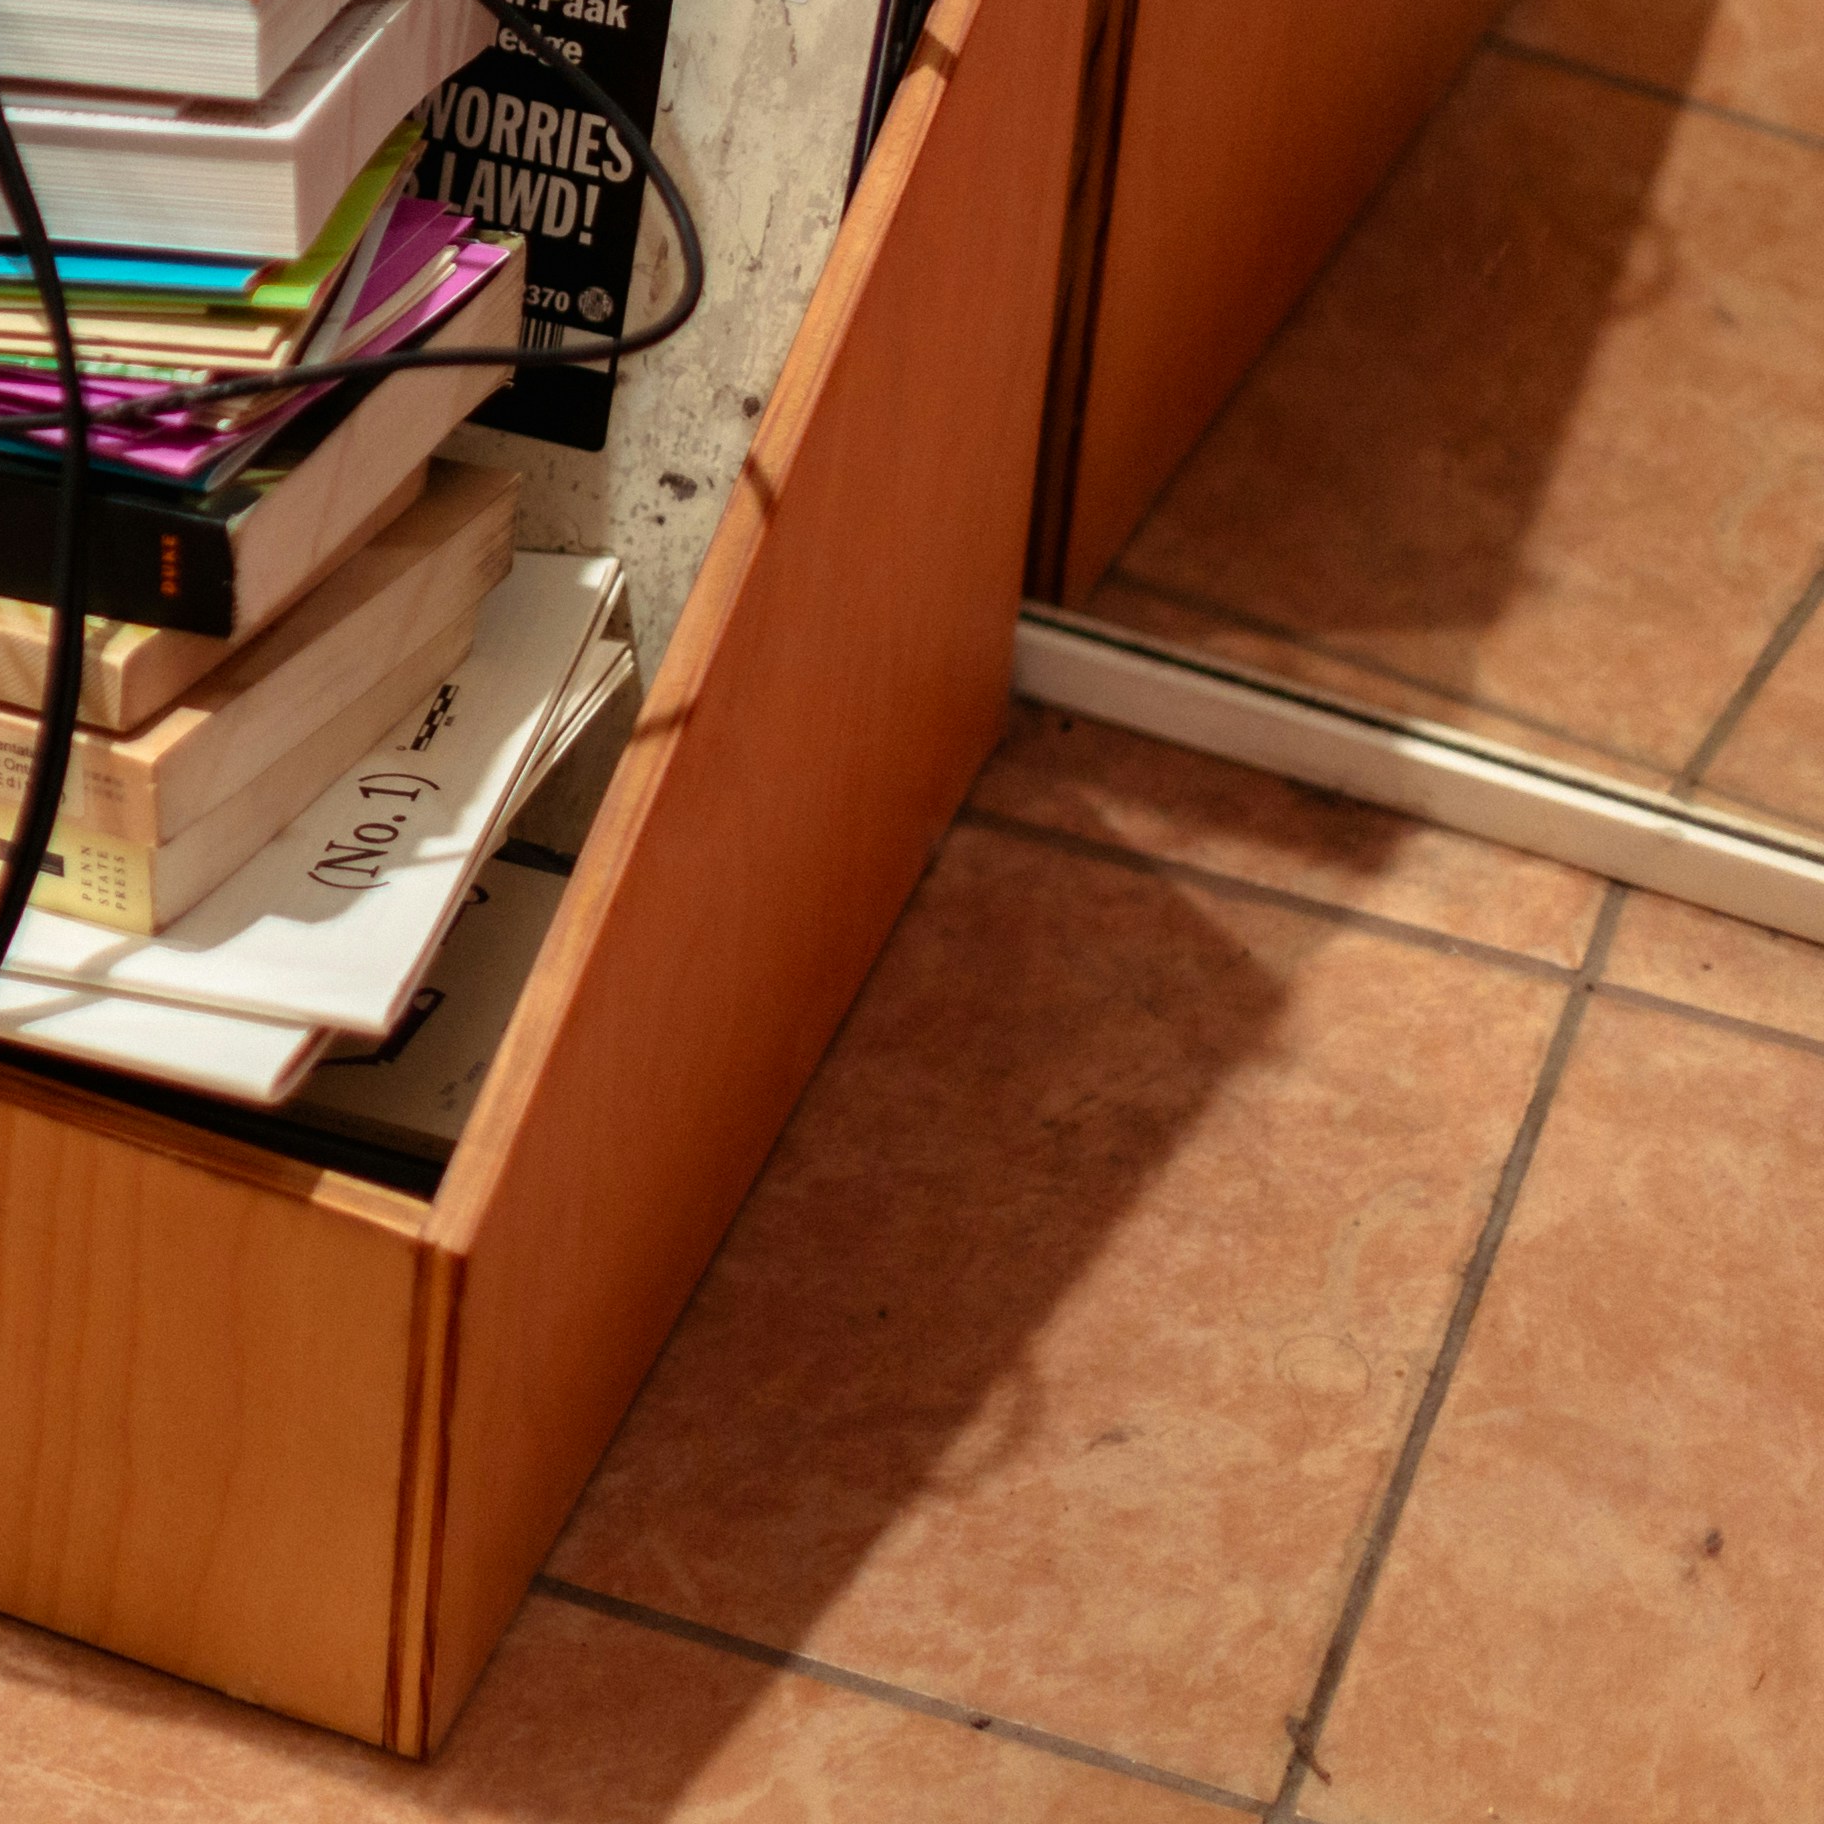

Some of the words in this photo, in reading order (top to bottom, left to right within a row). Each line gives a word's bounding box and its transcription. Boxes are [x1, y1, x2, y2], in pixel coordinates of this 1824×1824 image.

[412, 81, 634, 183] WORRIES
[437, 150, 601, 246] LAWD!
[307, 813, 407, 891] (No.
[357, 772, 442, 803] 1)
[80, 845, 93, 902] PENN
[96, 849, 110, 906] STATE
[112, 854, 127, 912] PRESS
